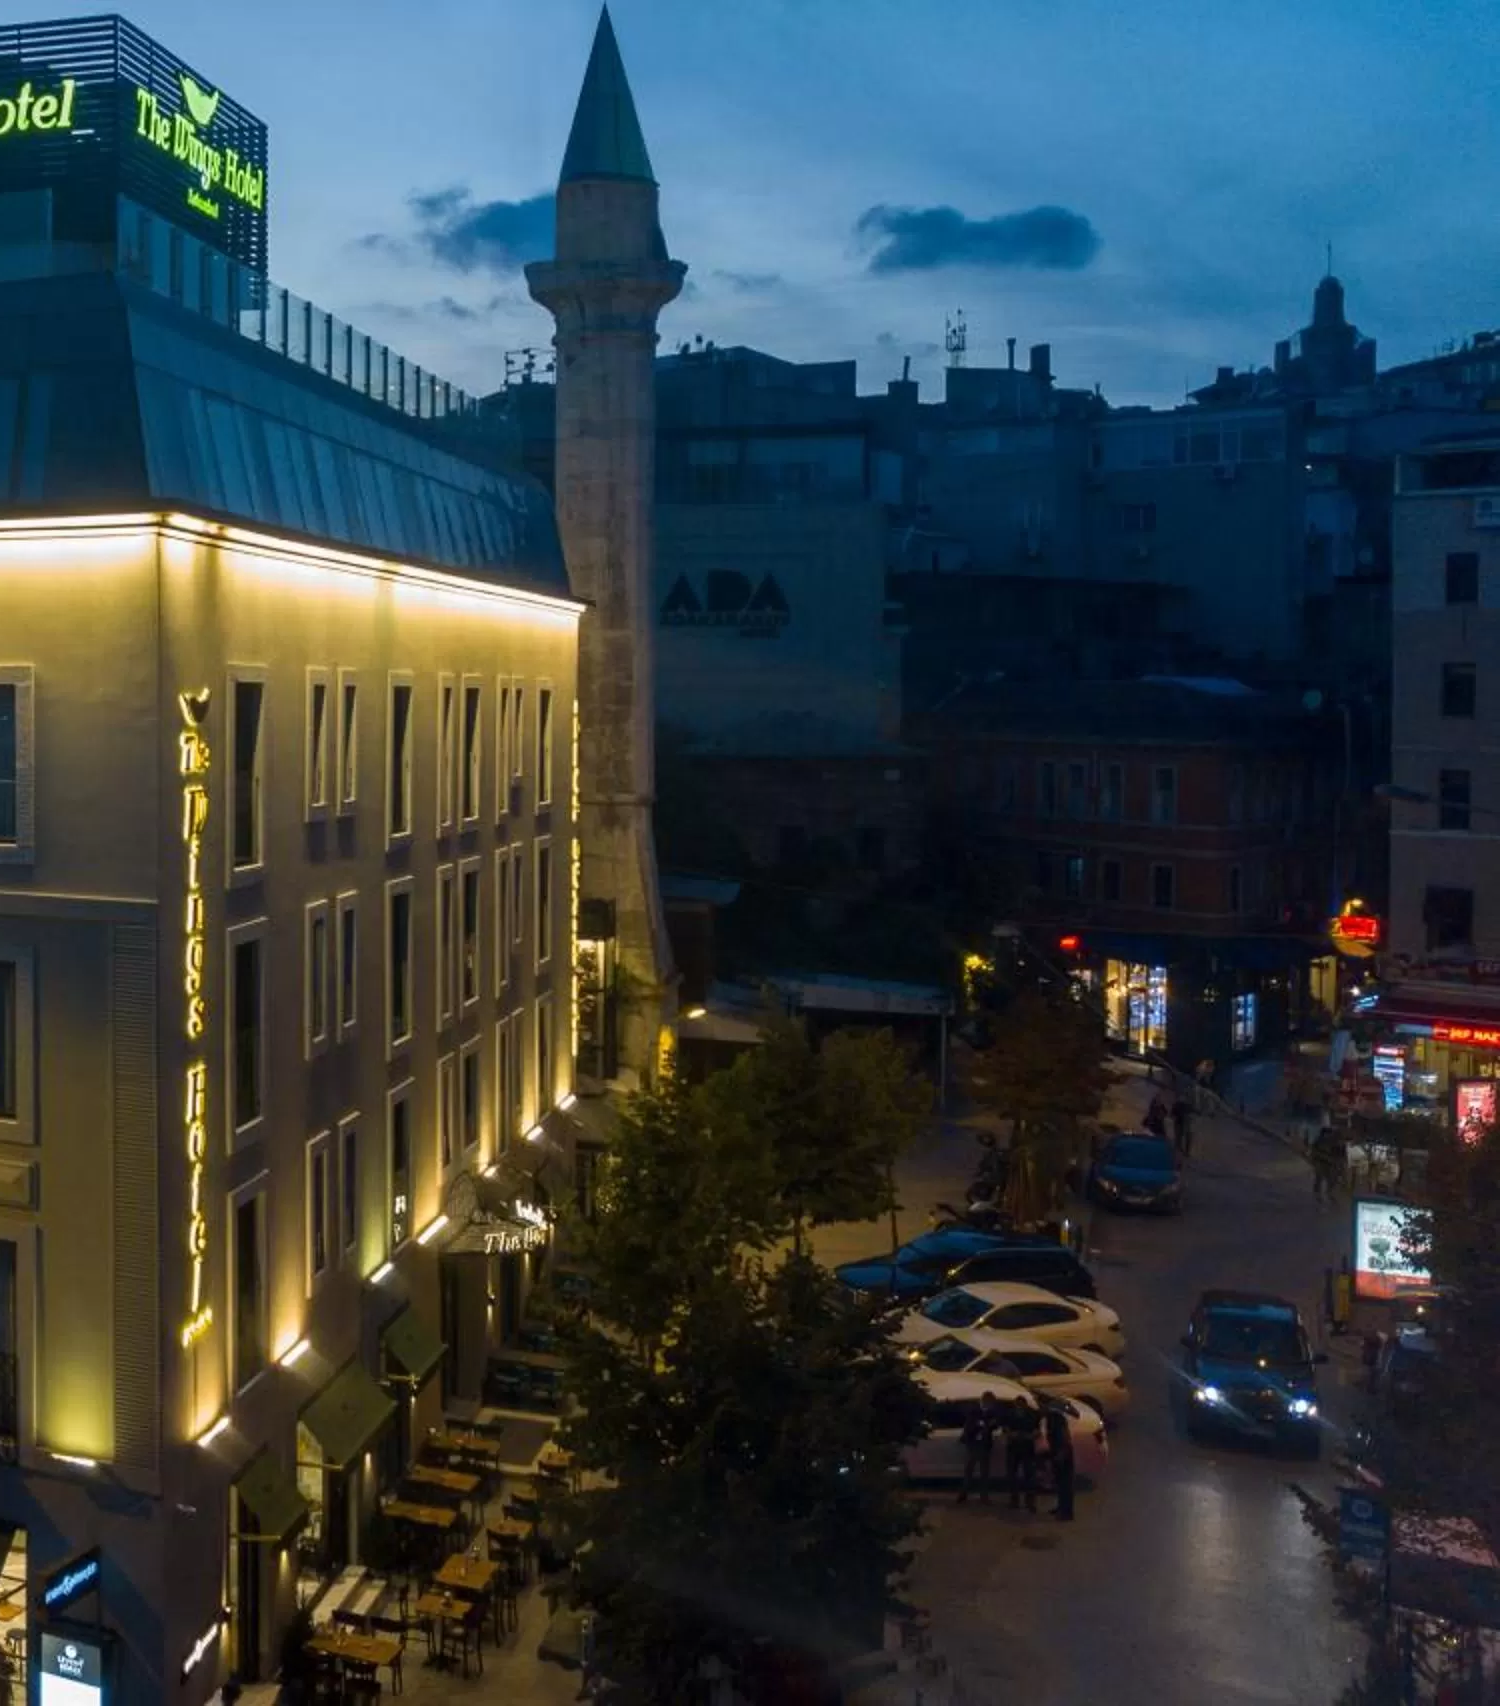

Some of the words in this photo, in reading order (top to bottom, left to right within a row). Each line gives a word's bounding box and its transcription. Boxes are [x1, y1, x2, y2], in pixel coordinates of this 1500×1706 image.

[137, 87, 171, 151] The
[173, 112, 221, 191] Wings
[224, 147, 263, 209] Hotel
